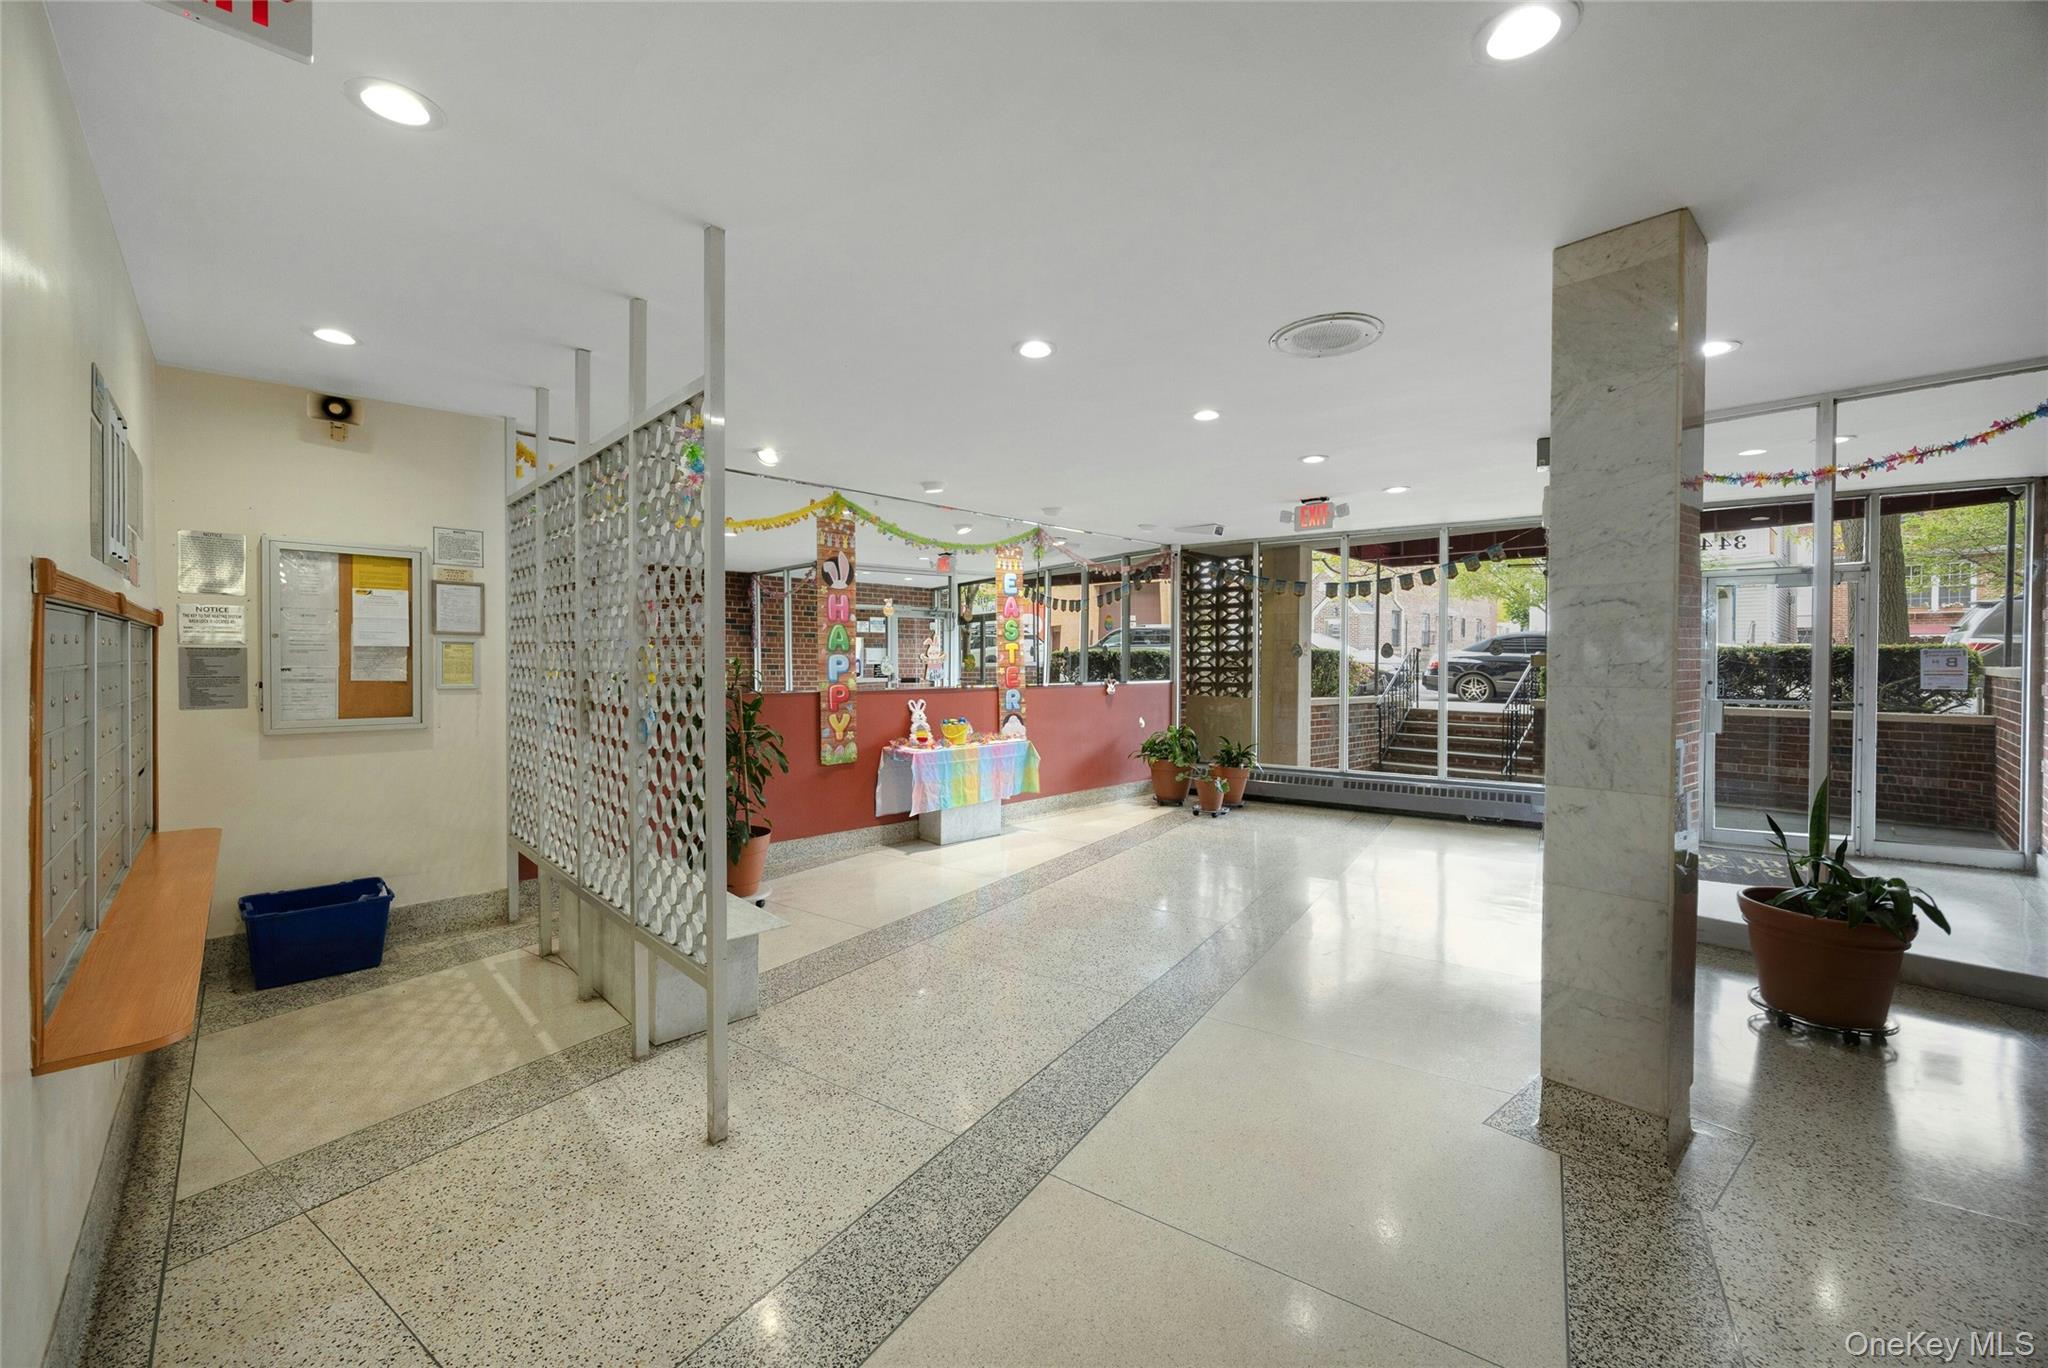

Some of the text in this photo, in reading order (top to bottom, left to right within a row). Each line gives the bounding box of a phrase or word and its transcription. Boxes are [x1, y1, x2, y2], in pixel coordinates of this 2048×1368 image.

[1299, 502, 1329, 529] EXIT
[826, 593, 851, 740] HAPPY
[1003, 572, 1021, 711] EASTER
